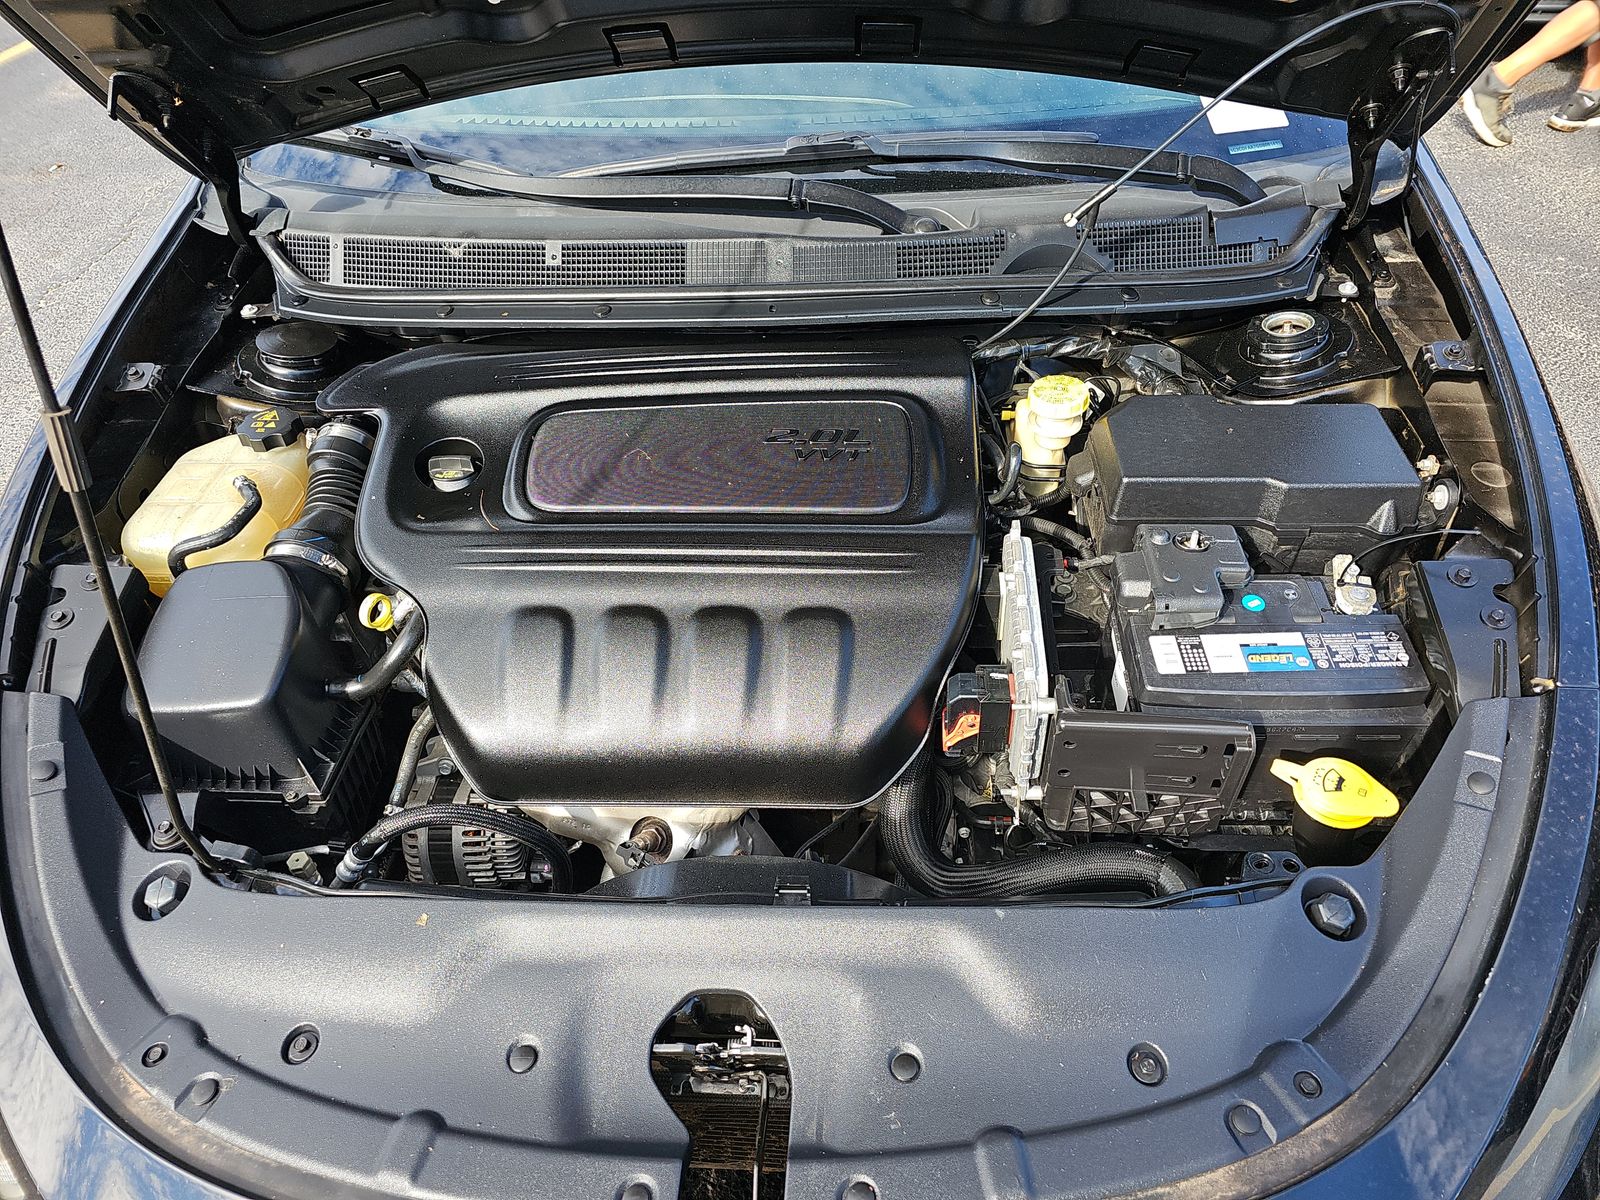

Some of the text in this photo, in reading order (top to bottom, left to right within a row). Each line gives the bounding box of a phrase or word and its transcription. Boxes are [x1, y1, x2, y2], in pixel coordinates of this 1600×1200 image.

[763, 428, 871, 445] 2.0L
[794, 447, 873, 462] VVT
[1248, 653, 1294, 663] LEGEND
